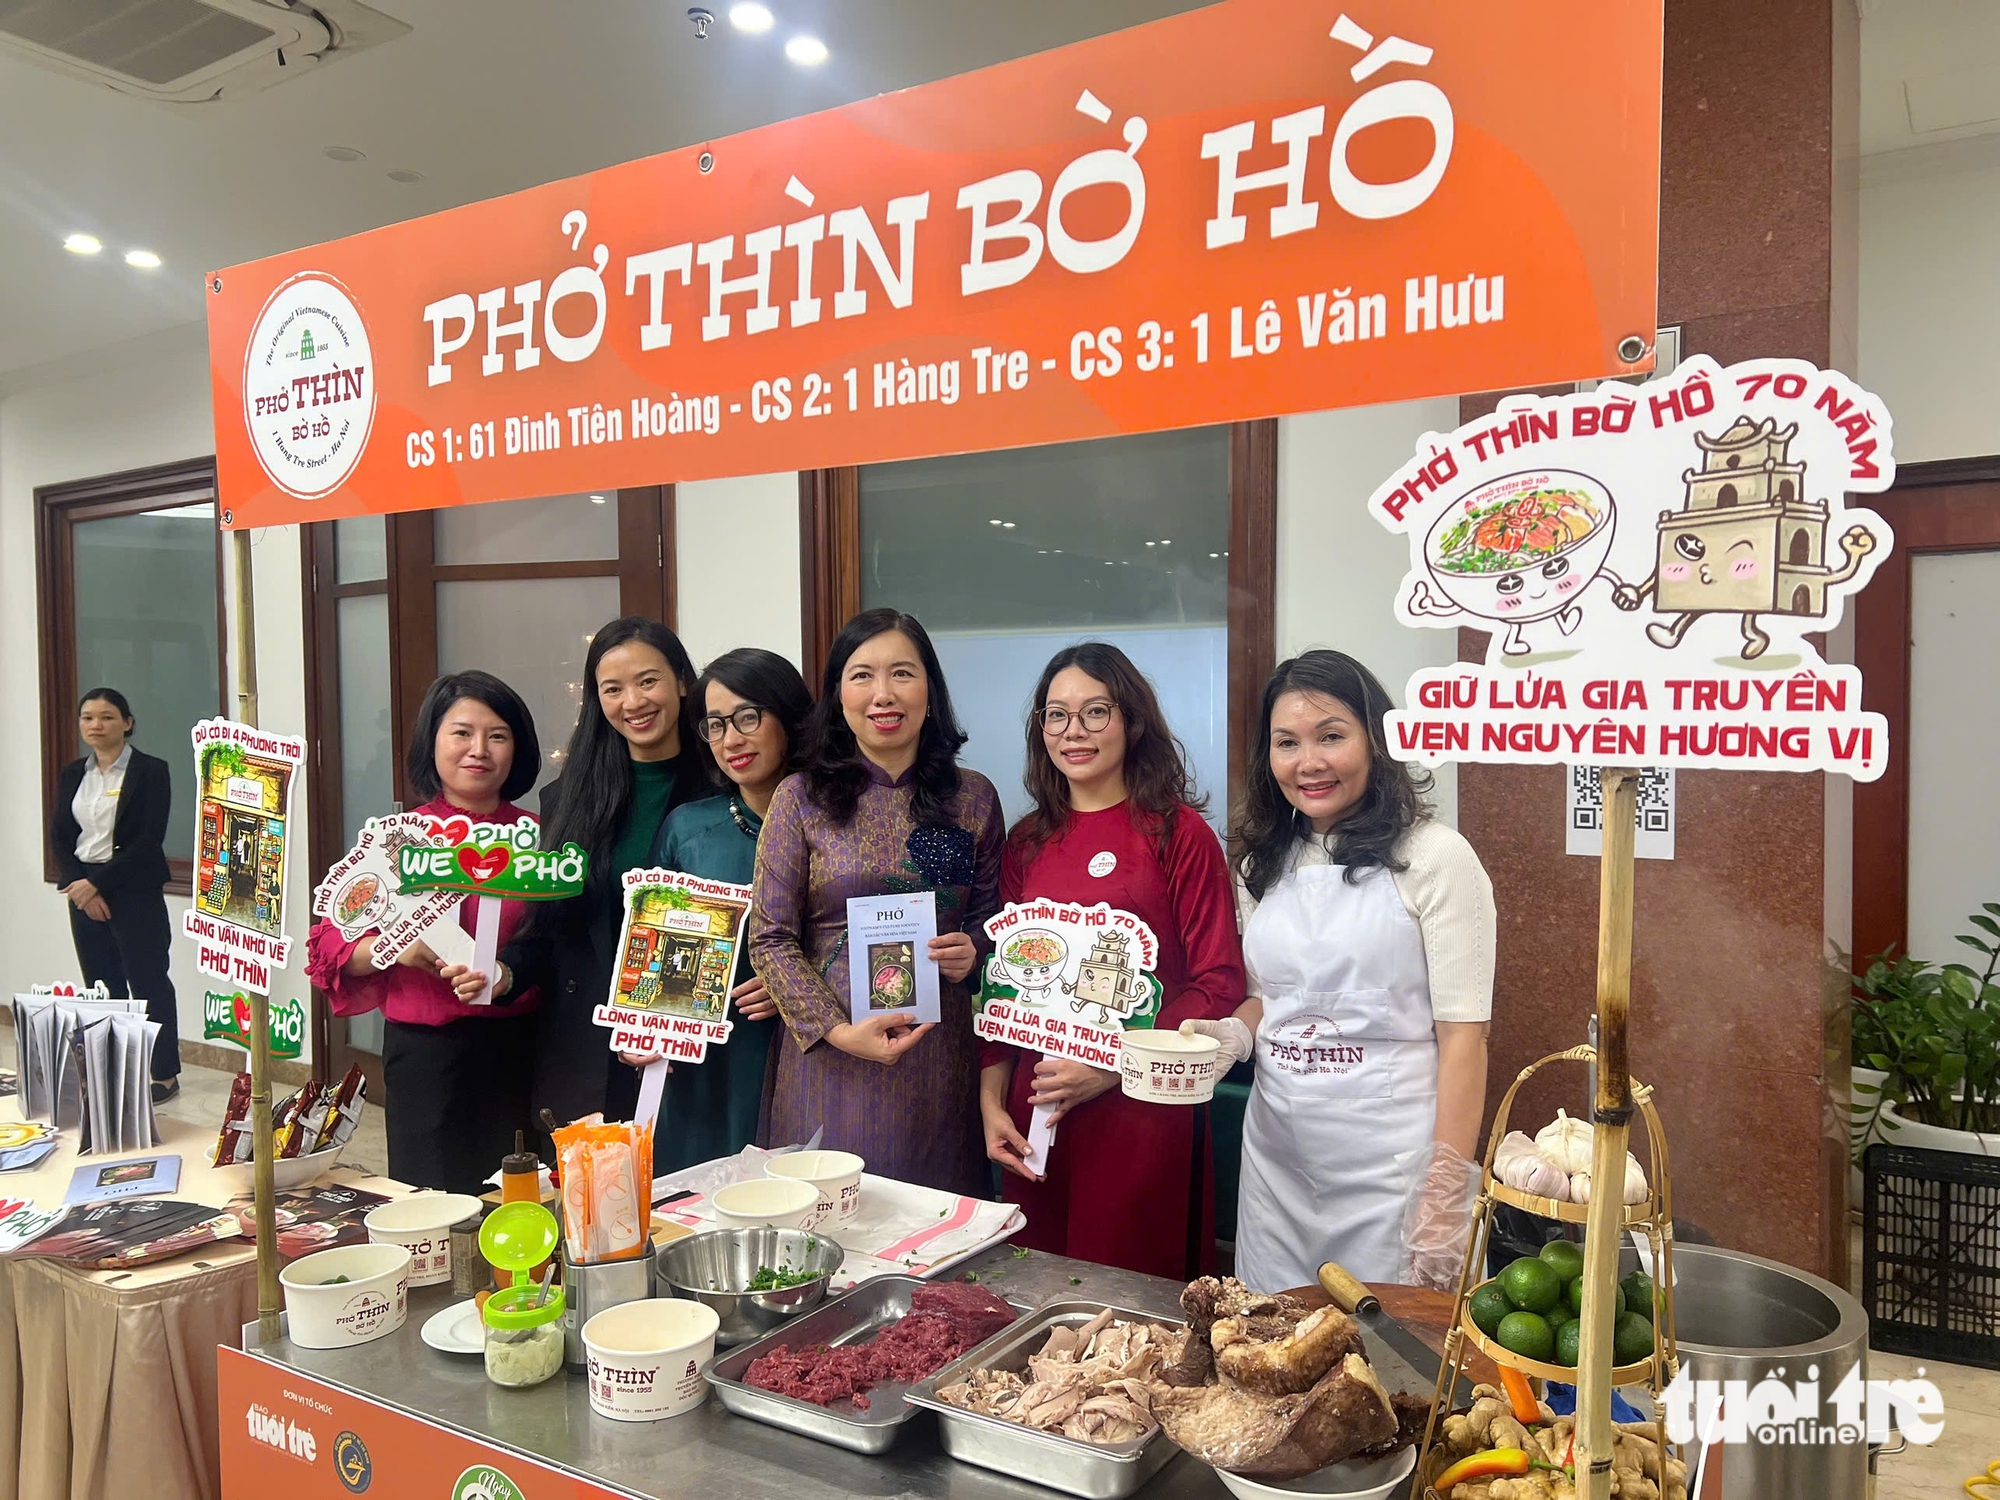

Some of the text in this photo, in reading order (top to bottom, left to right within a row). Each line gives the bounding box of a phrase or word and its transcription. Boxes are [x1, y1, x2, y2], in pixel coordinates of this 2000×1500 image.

[422, 13, 1455, 387] PHỞ THÌN BỜ HỒ
[265, 306, 350, 366] The Original Vietnamese Cuisine
[255, 361, 364, 416] PHỞ THÌN
[406, 429, 436, 469] CS
[442, 427, 463, 463] 1:
[469, 421, 495, 460] 61
[504, 411, 561, 455] Đinh
[567, 403, 622, 447] Tiên
[631, 391, 720, 439] Hoàng
[751, 381, 792, 422] CS
[802, 376, 832, 418] 2:
[844, 372, 858, 412] 1
[875, 358, 960, 410] Hàng
[971, 346, 1029, 394] Tre
[1070, 329, 1123, 381] CS
[1136, 320, 1175, 373] 3:
[1190, 314, 1208, 364] 1
[1230, 299, 1281, 358] Lê
[1297, 286, 1387, 348] Văn
[1405, 273, 1505, 334] Hưu
[275, 437, 293, 461] Hang
[292, 455, 306, 468] Tre
[306, 454, 327, 469] Street
[330, 440, 342, 455] Ha
[339, 418, 350, 440] Noi
[291, 413, 331, 441] BỜ HỒ
[1381, 369, 1881, 523] PHỞ THÌN BỜ HỒ 70 NĂM
[1418, 668, 1847, 712] GIỮ LỬA GIA TRUYỀN
[221, 727, 231, 740] ĐI
[232, 728, 239, 742] 4
[240, 731, 278, 754] PHƯƠNG
[1397, 716, 1873, 768] VẸN NGUYÊN HƯƠNG VỊ
[472, 820, 537, 851] PHỞ
[316, 885, 333, 913] PHỞ
[326, 863, 351, 886] THÌN
[348, 849, 366, 866] BỜ
[379, 817, 397, 831] 70
[400, 815, 430, 832] NĂM
[402, 847, 584, 883] WE PHỞ
[662, 873, 674, 885] ĐI
[676, 877, 685, 886] 4
[686, 879, 731, 897] PHƯƠNG
[412, 904, 430, 922] GIA
[877, 907, 904, 921] PHỞ
[186, 914, 215, 939] LÒNG
[242, 934, 266, 956] NHỚ
[988, 902, 1154, 967] PHỞ THÌN BỜ HỒ 70 NĂM
[200, 944, 268, 989] PHỞ THÌN
[205, 994, 232, 1025] WE
[598, 1008, 637, 1026] LÒNG
[673, 1020, 702, 1037] NHỚ
[1045, 1018, 1067, 1035] GIA
[615, 1028, 703, 1059] PHỞ THÌN
[978, 1019, 1116, 1066] VẸN NGUYÊN HƯƠNG
[1269, 1040, 1364, 1064] PHỞ THÌN
[1150, 1059, 1185, 1075] PHỞ
[603, 1366, 656, 1385] THÌN
[246, 1402, 286, 1451] tuổi
[286, 1418, 317, 1462] trẻ
